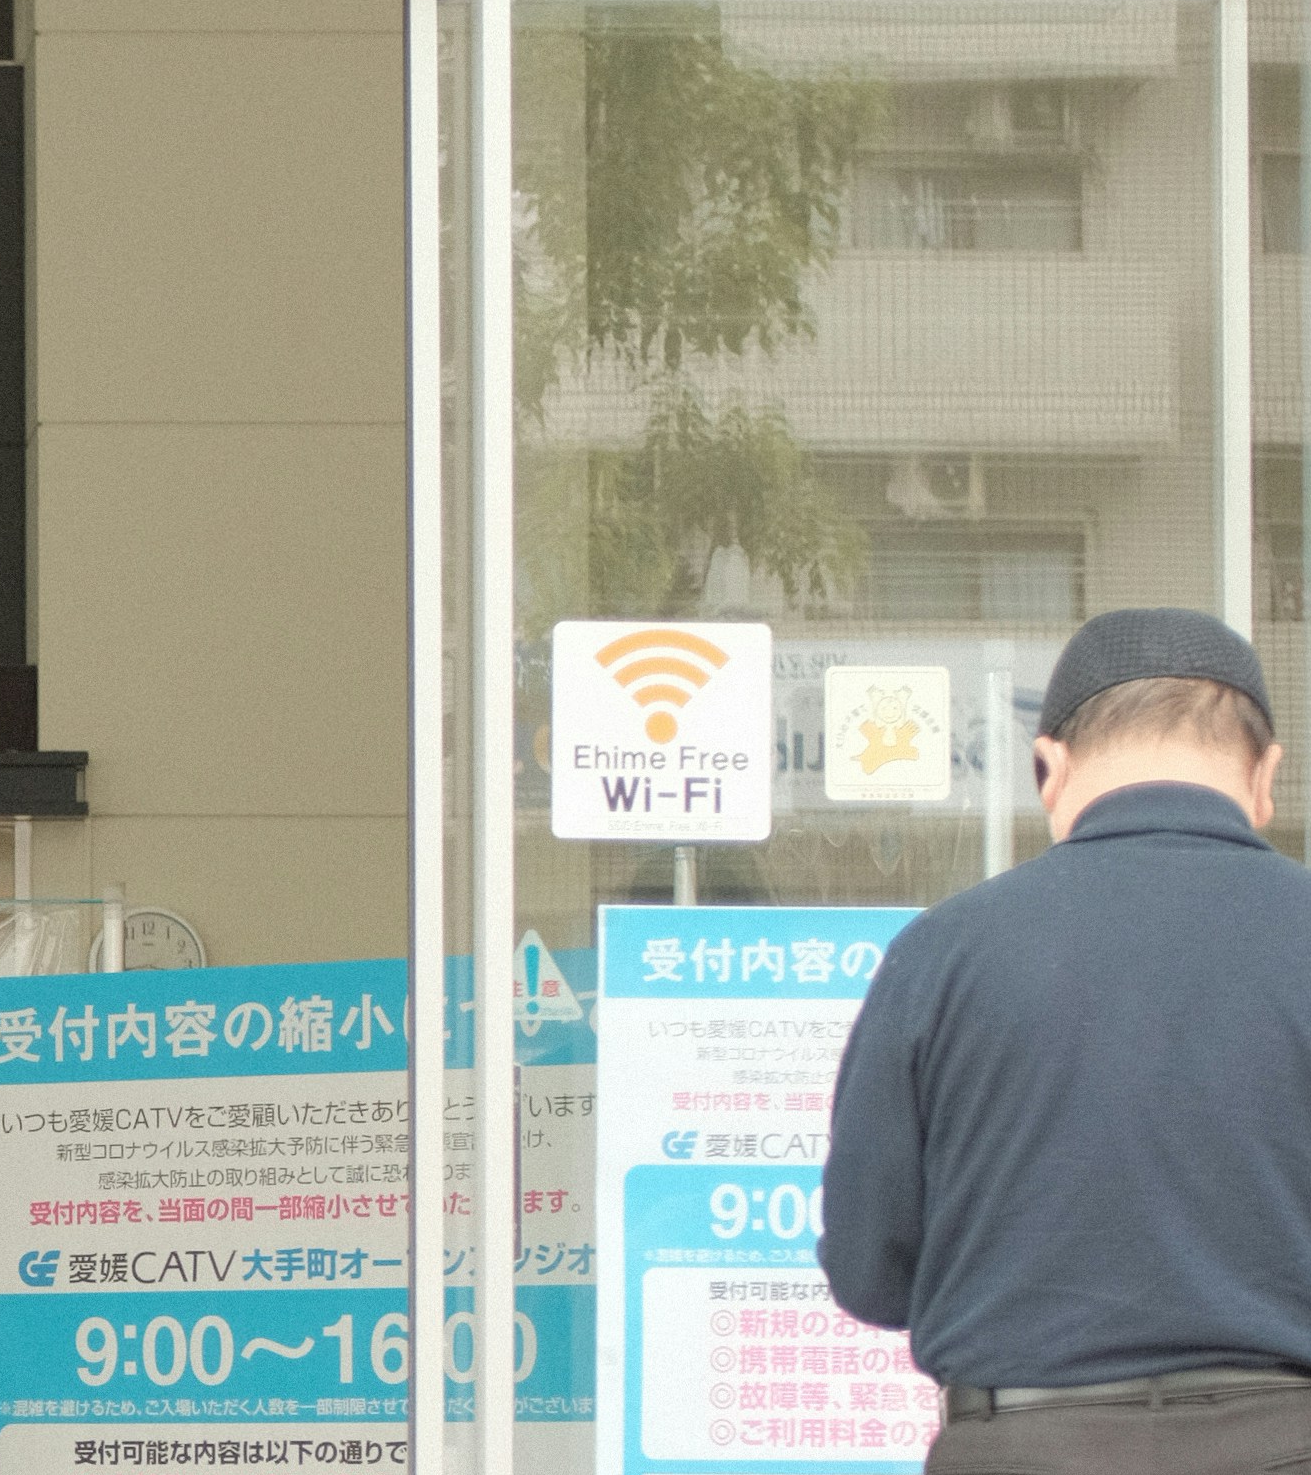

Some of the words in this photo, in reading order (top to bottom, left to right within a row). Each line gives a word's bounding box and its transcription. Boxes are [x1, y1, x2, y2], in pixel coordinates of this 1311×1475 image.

[574, 745, 666, 770] Ehime
[679, 746, 749, 771] Free
[600, 776, 722, 814] Wi-Fi
[642, 937, 883, 984] 受付内容の
[705, 1133, 831, 1158] 愛媛CAT
